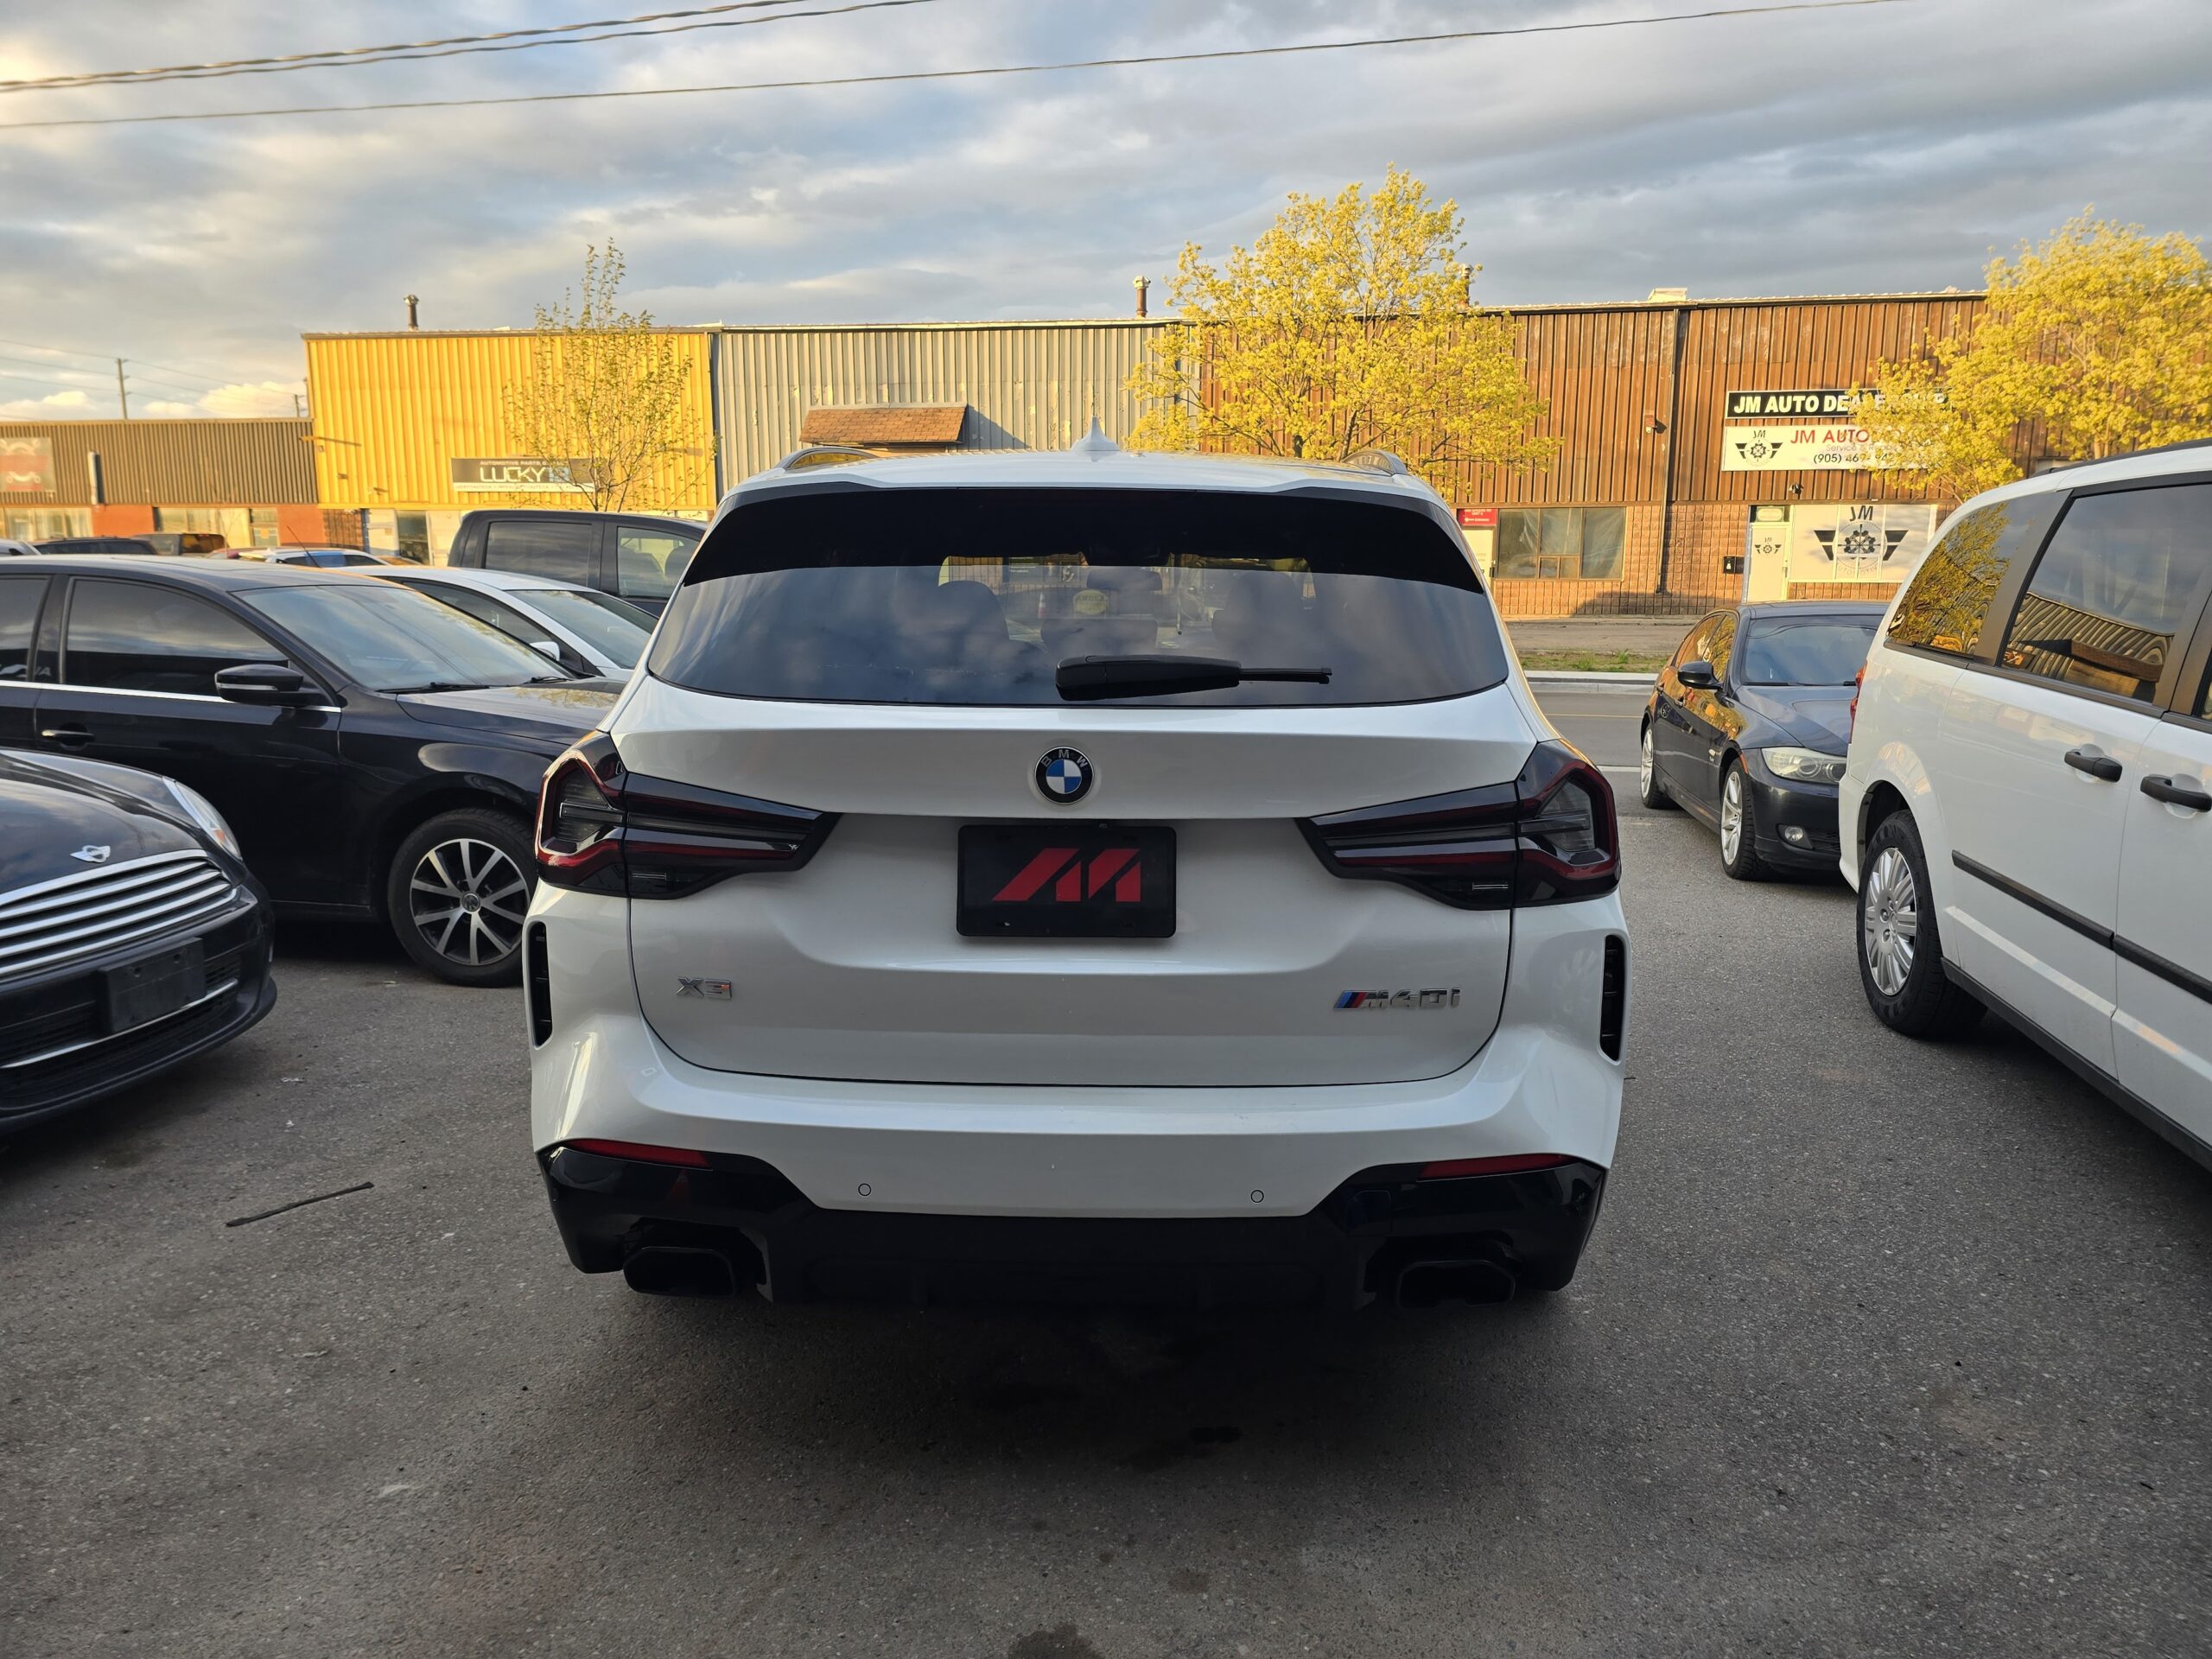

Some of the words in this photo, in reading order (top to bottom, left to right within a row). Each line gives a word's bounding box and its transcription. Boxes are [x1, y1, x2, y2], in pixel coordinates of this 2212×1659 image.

[1734, 396, 1761, 414] JM
[1764, 395, 1819, 414] AUTO
[1790, 429, 1815, 443] JM
[1814, 454, 1841, 464] (905)
[1849, 505, 1874, 522] JM
[676, 976, 733, 1000] X3
